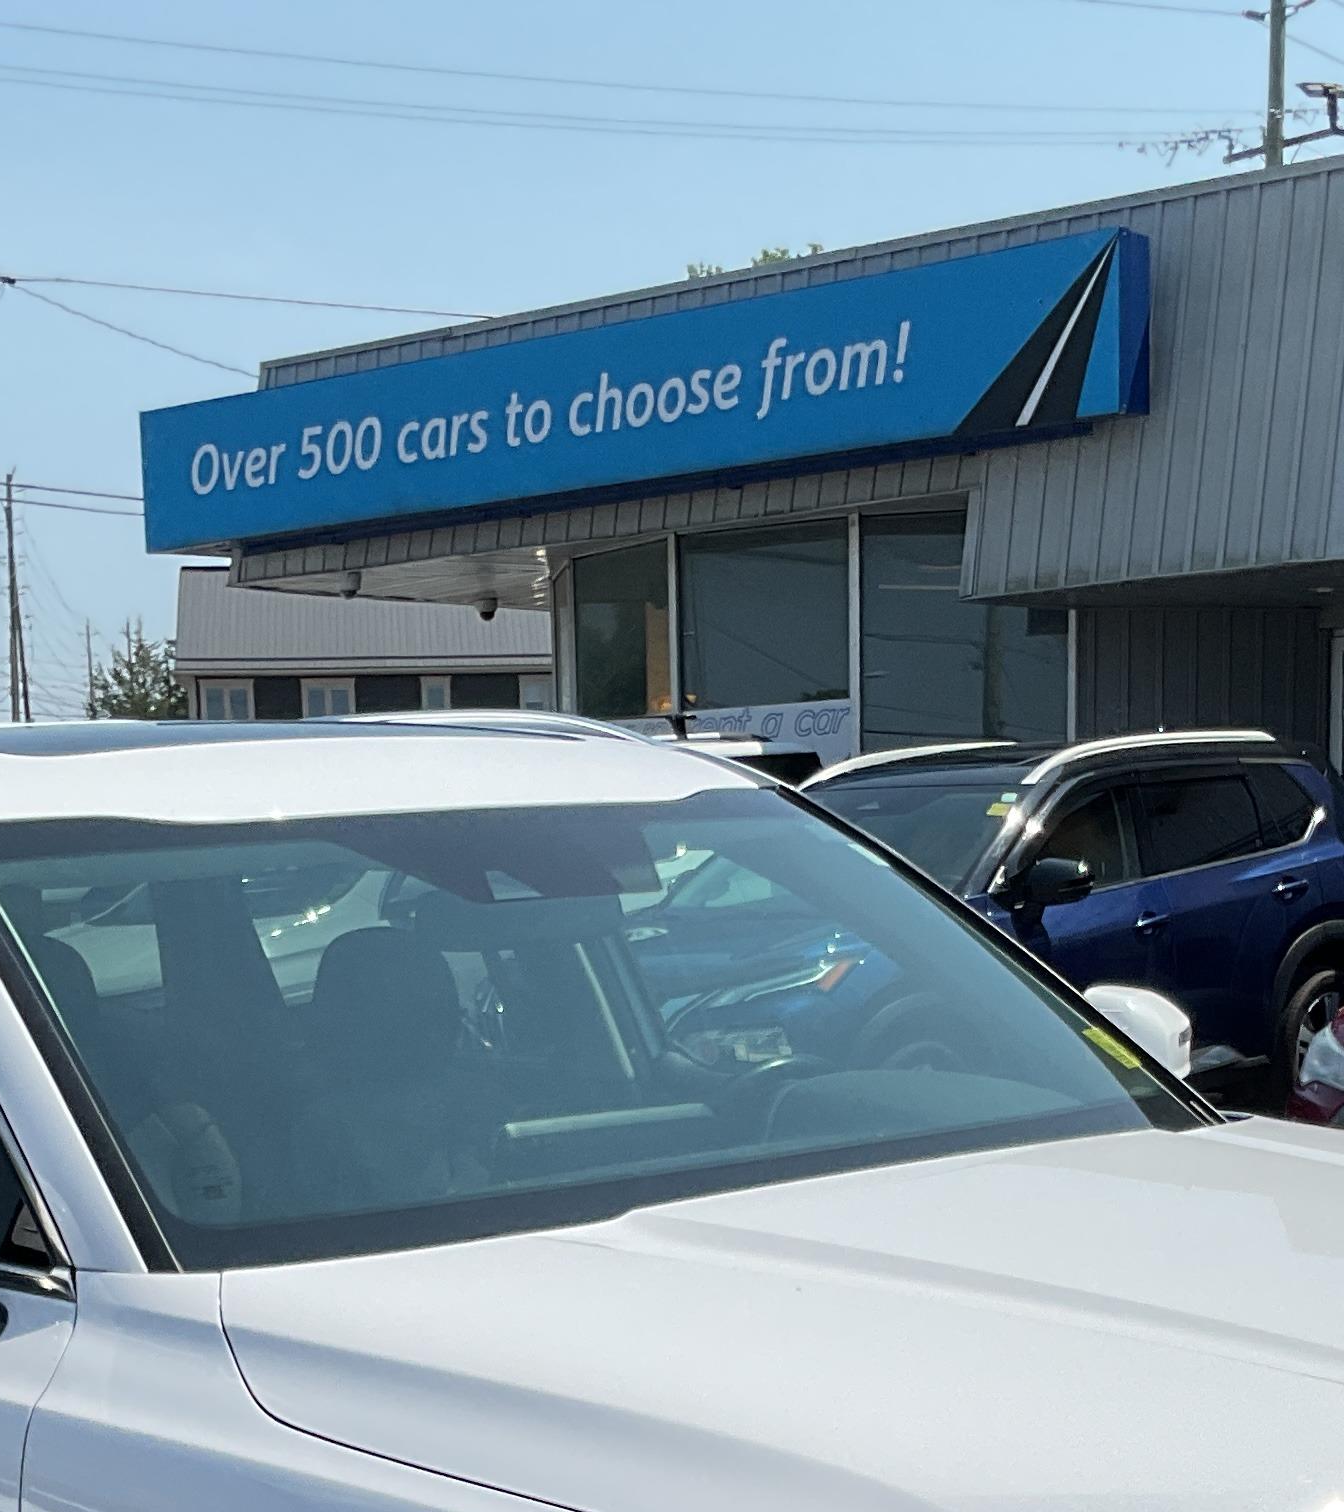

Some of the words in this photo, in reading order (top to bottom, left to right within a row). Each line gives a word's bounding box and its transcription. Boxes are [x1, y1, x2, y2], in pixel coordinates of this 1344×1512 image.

[191, 443, 286, 495] Over
[297, 416, 382, 479] 500
[397, 409, 489, 464] cars
[506, 392, 552, 447] to
[568, 363, 743, 437] choose
[756, 320, 911, 420] from!
[761, 712, 784, 738] a
[794, 706, 851, 737] car
